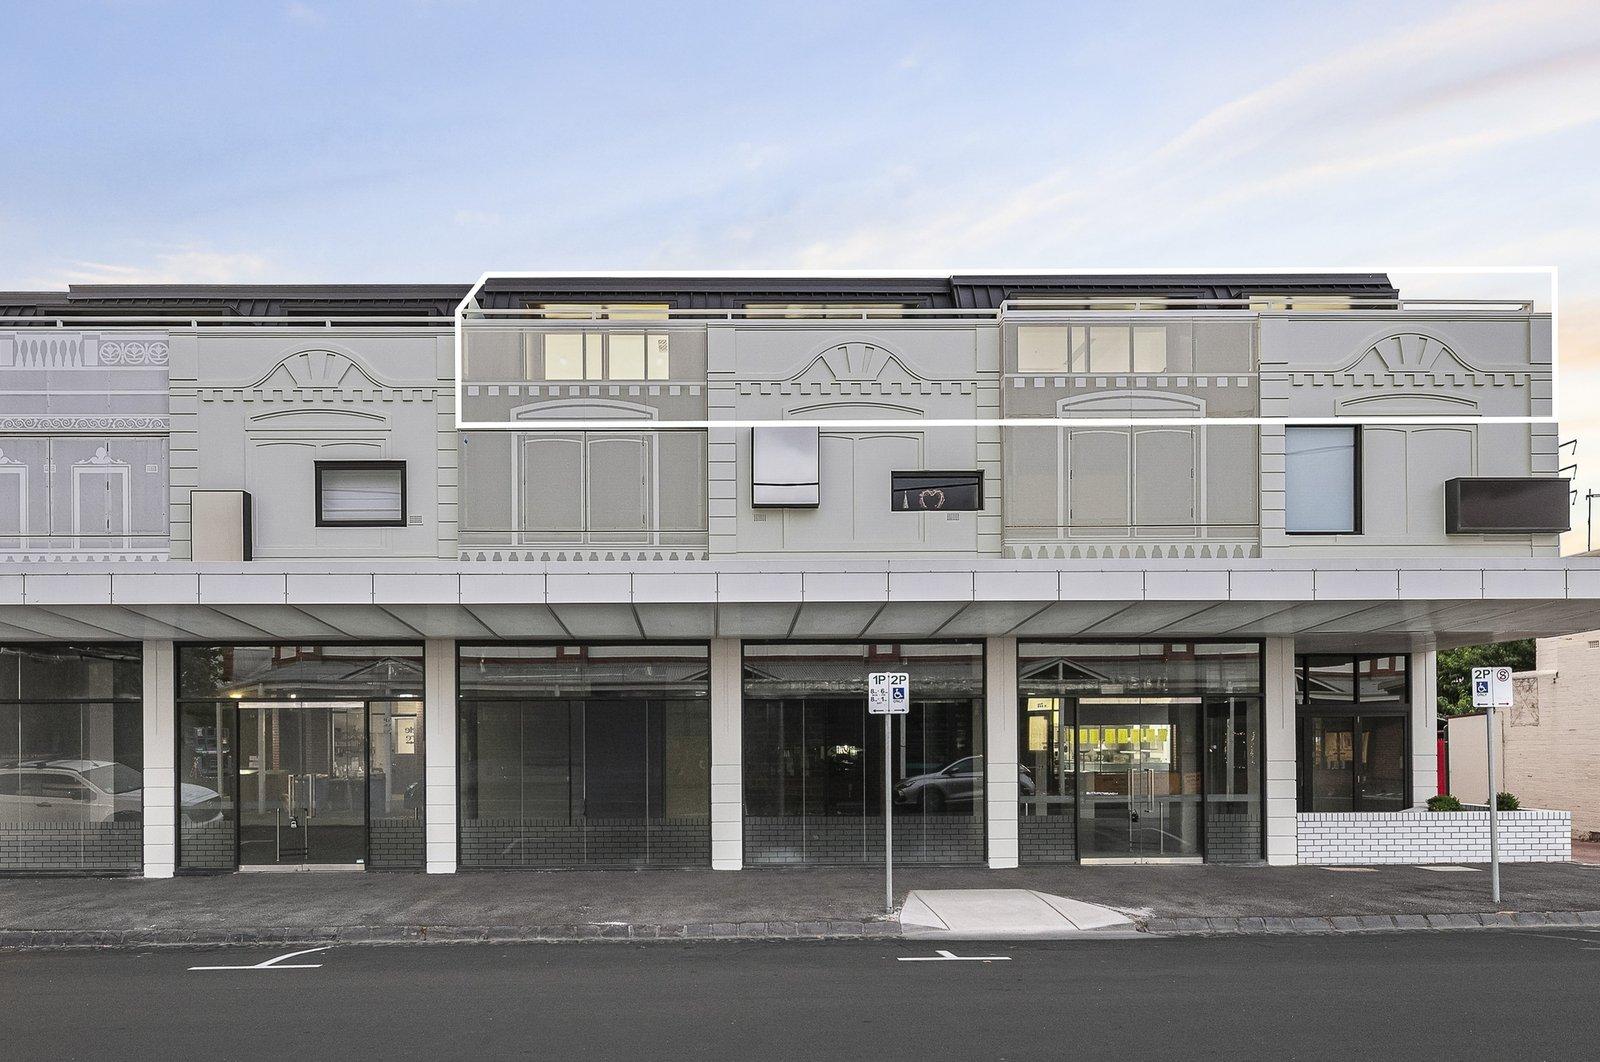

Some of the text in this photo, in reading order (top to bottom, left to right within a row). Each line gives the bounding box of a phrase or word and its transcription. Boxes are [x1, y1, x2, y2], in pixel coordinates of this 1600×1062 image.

[1474, 669, 1490, 679] 2P
[872, 675, 886, 685] 1P
[891, 675, 907, 685] 2P
